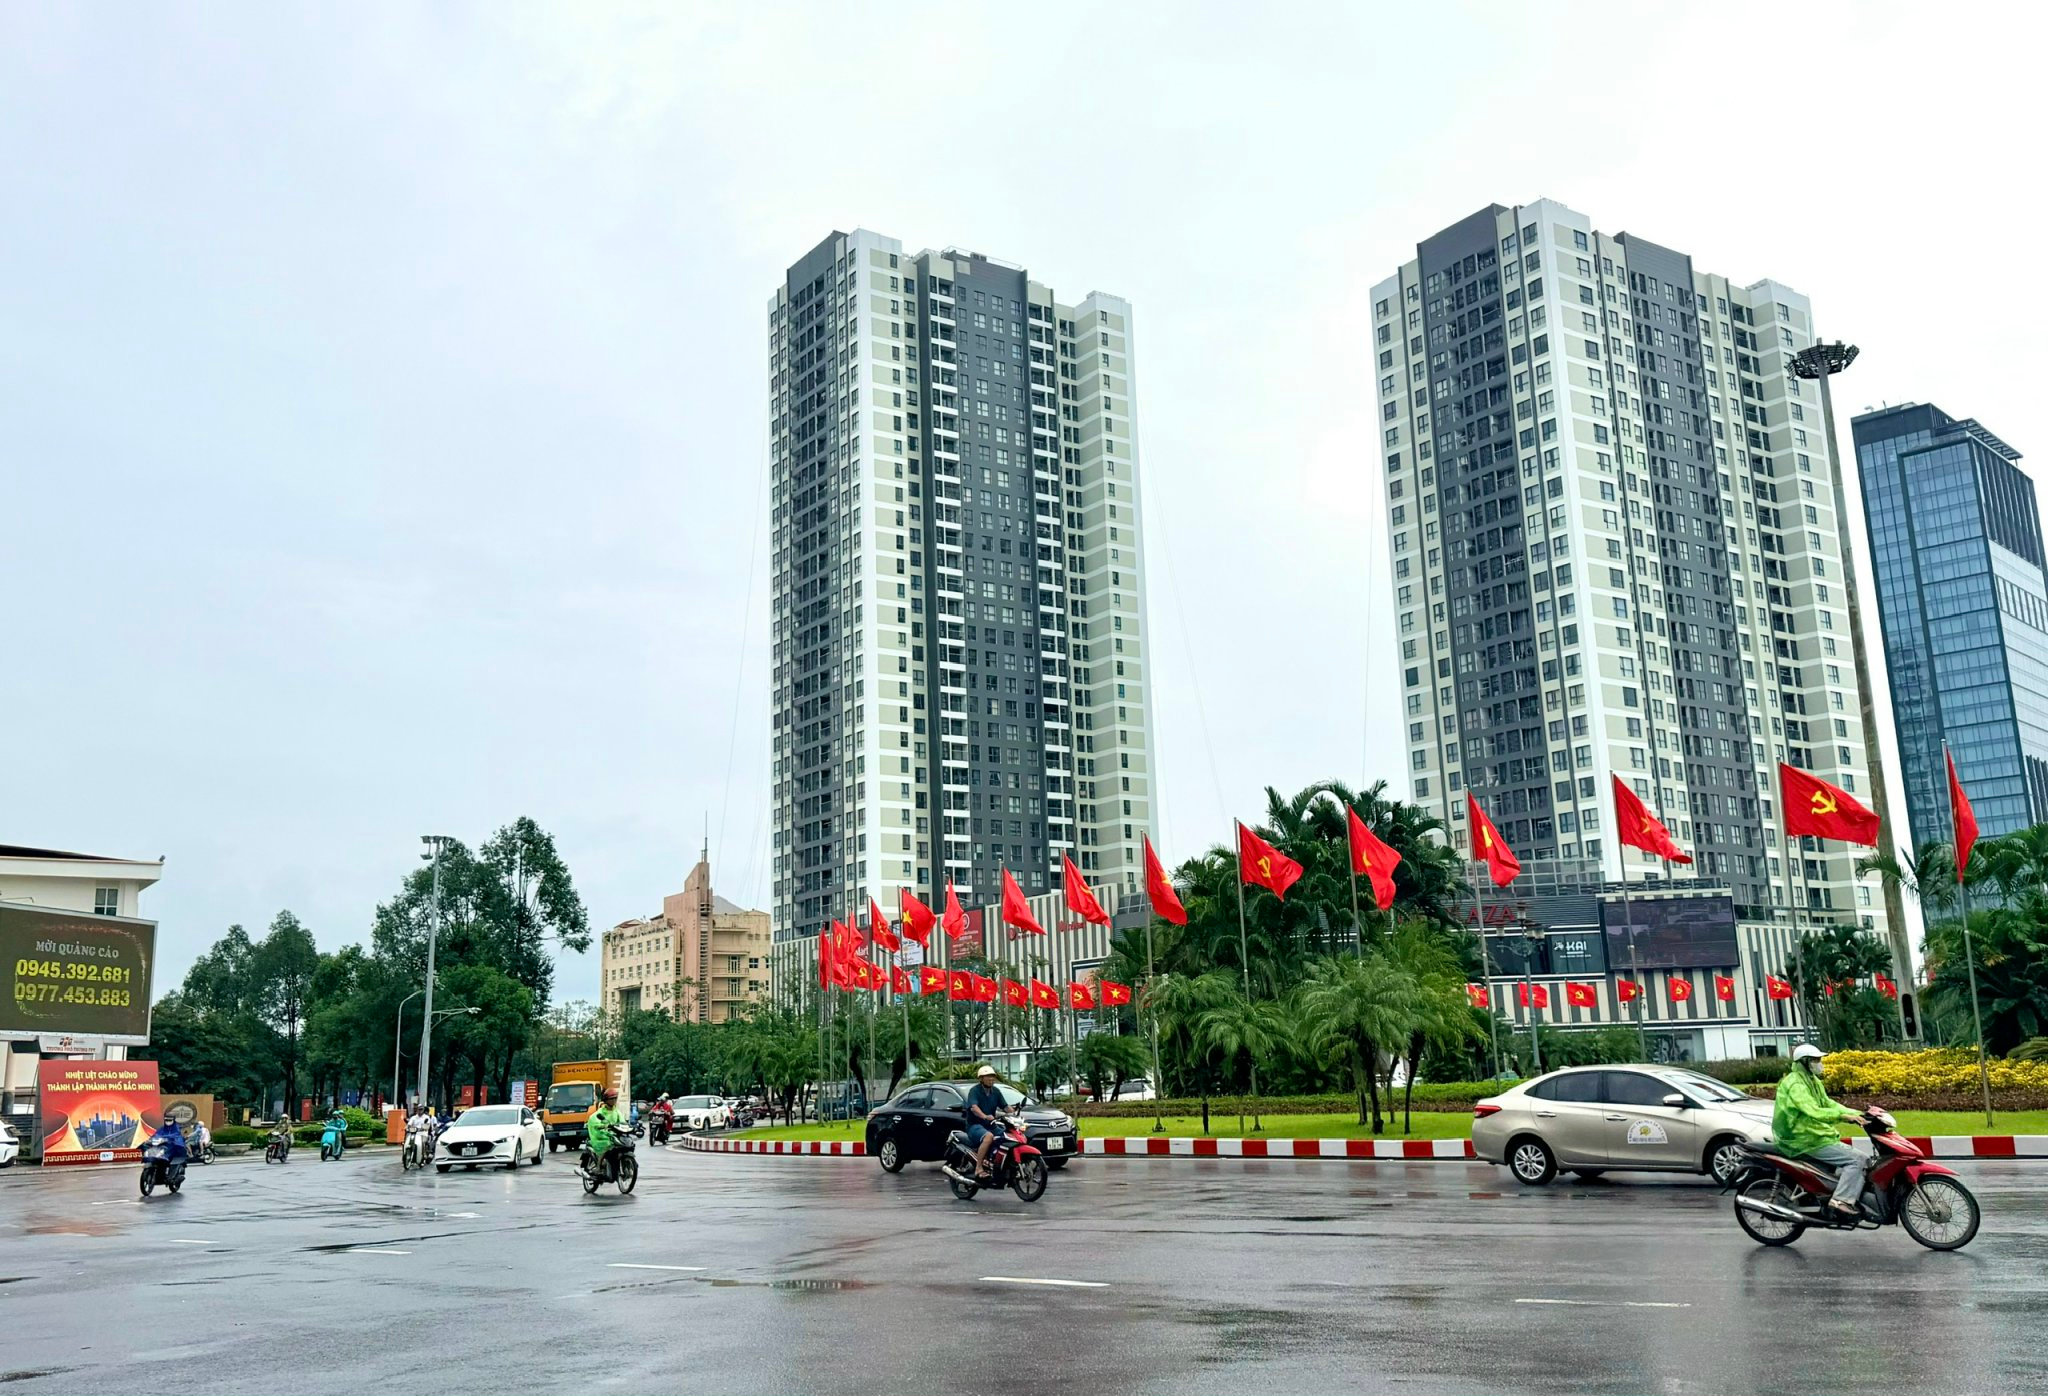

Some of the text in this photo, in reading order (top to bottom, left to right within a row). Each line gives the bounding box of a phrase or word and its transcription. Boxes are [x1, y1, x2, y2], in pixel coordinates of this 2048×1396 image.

[36, 939, 120, 958] MỜI QUẢNG CÁO
[1566, 941, 1587, 951] KAI
[16, 959, 131, 984] 0945.392.681
[15, 982, 130, 1007] 0977.453.883
[65, 1070, 138, 1081] NHIỆT LIỆT CHÀO MỪNG
[47, 1082, 70, 1091] THÀNH
[71, 1082, 84, 1093] LẬP
[85, 1082, 107, 1091] THÀNH
[108, 1080, 122, 1091] PHỐ
[123, 1080, 137, 1091] BẮC
